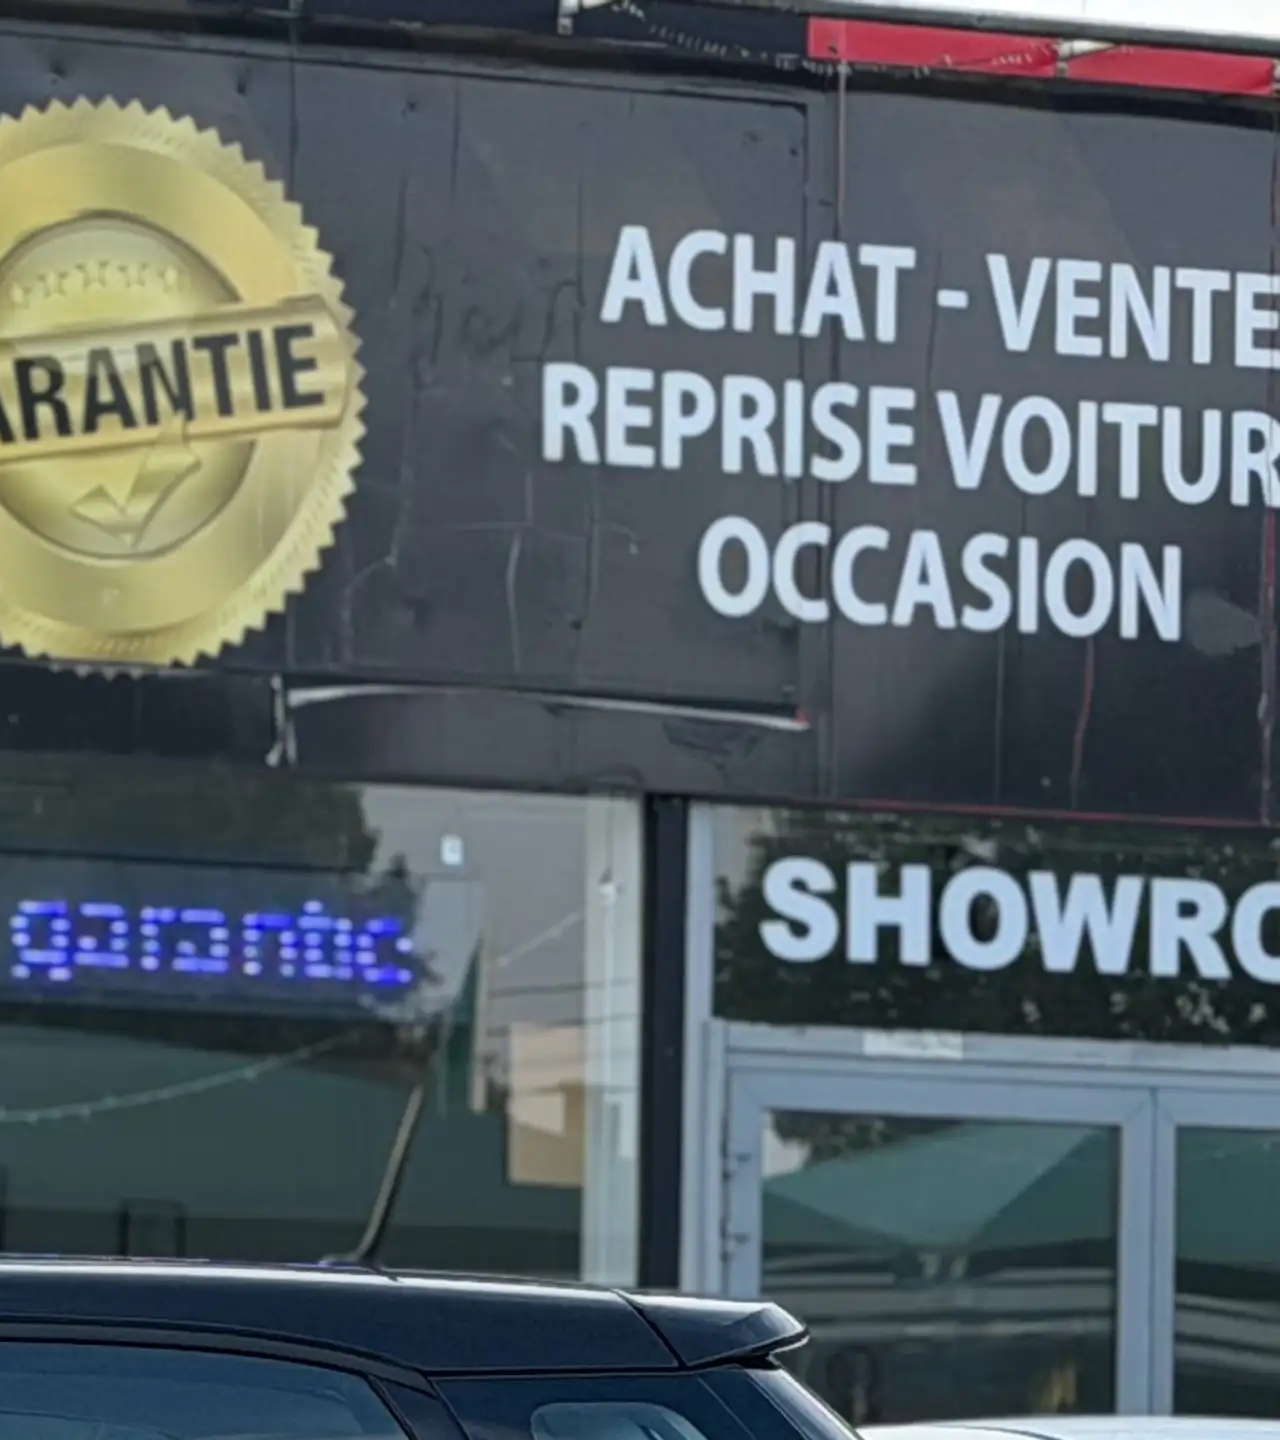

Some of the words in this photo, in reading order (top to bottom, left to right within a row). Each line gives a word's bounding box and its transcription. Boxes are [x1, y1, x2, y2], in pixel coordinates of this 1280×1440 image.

[600, 224, 916, 343] ACHAT
[986, 254, 1280, 369] VENTE
[543, 362, 917, 485] REPRISE
[698, 515, 1181, 642] OCCASION
